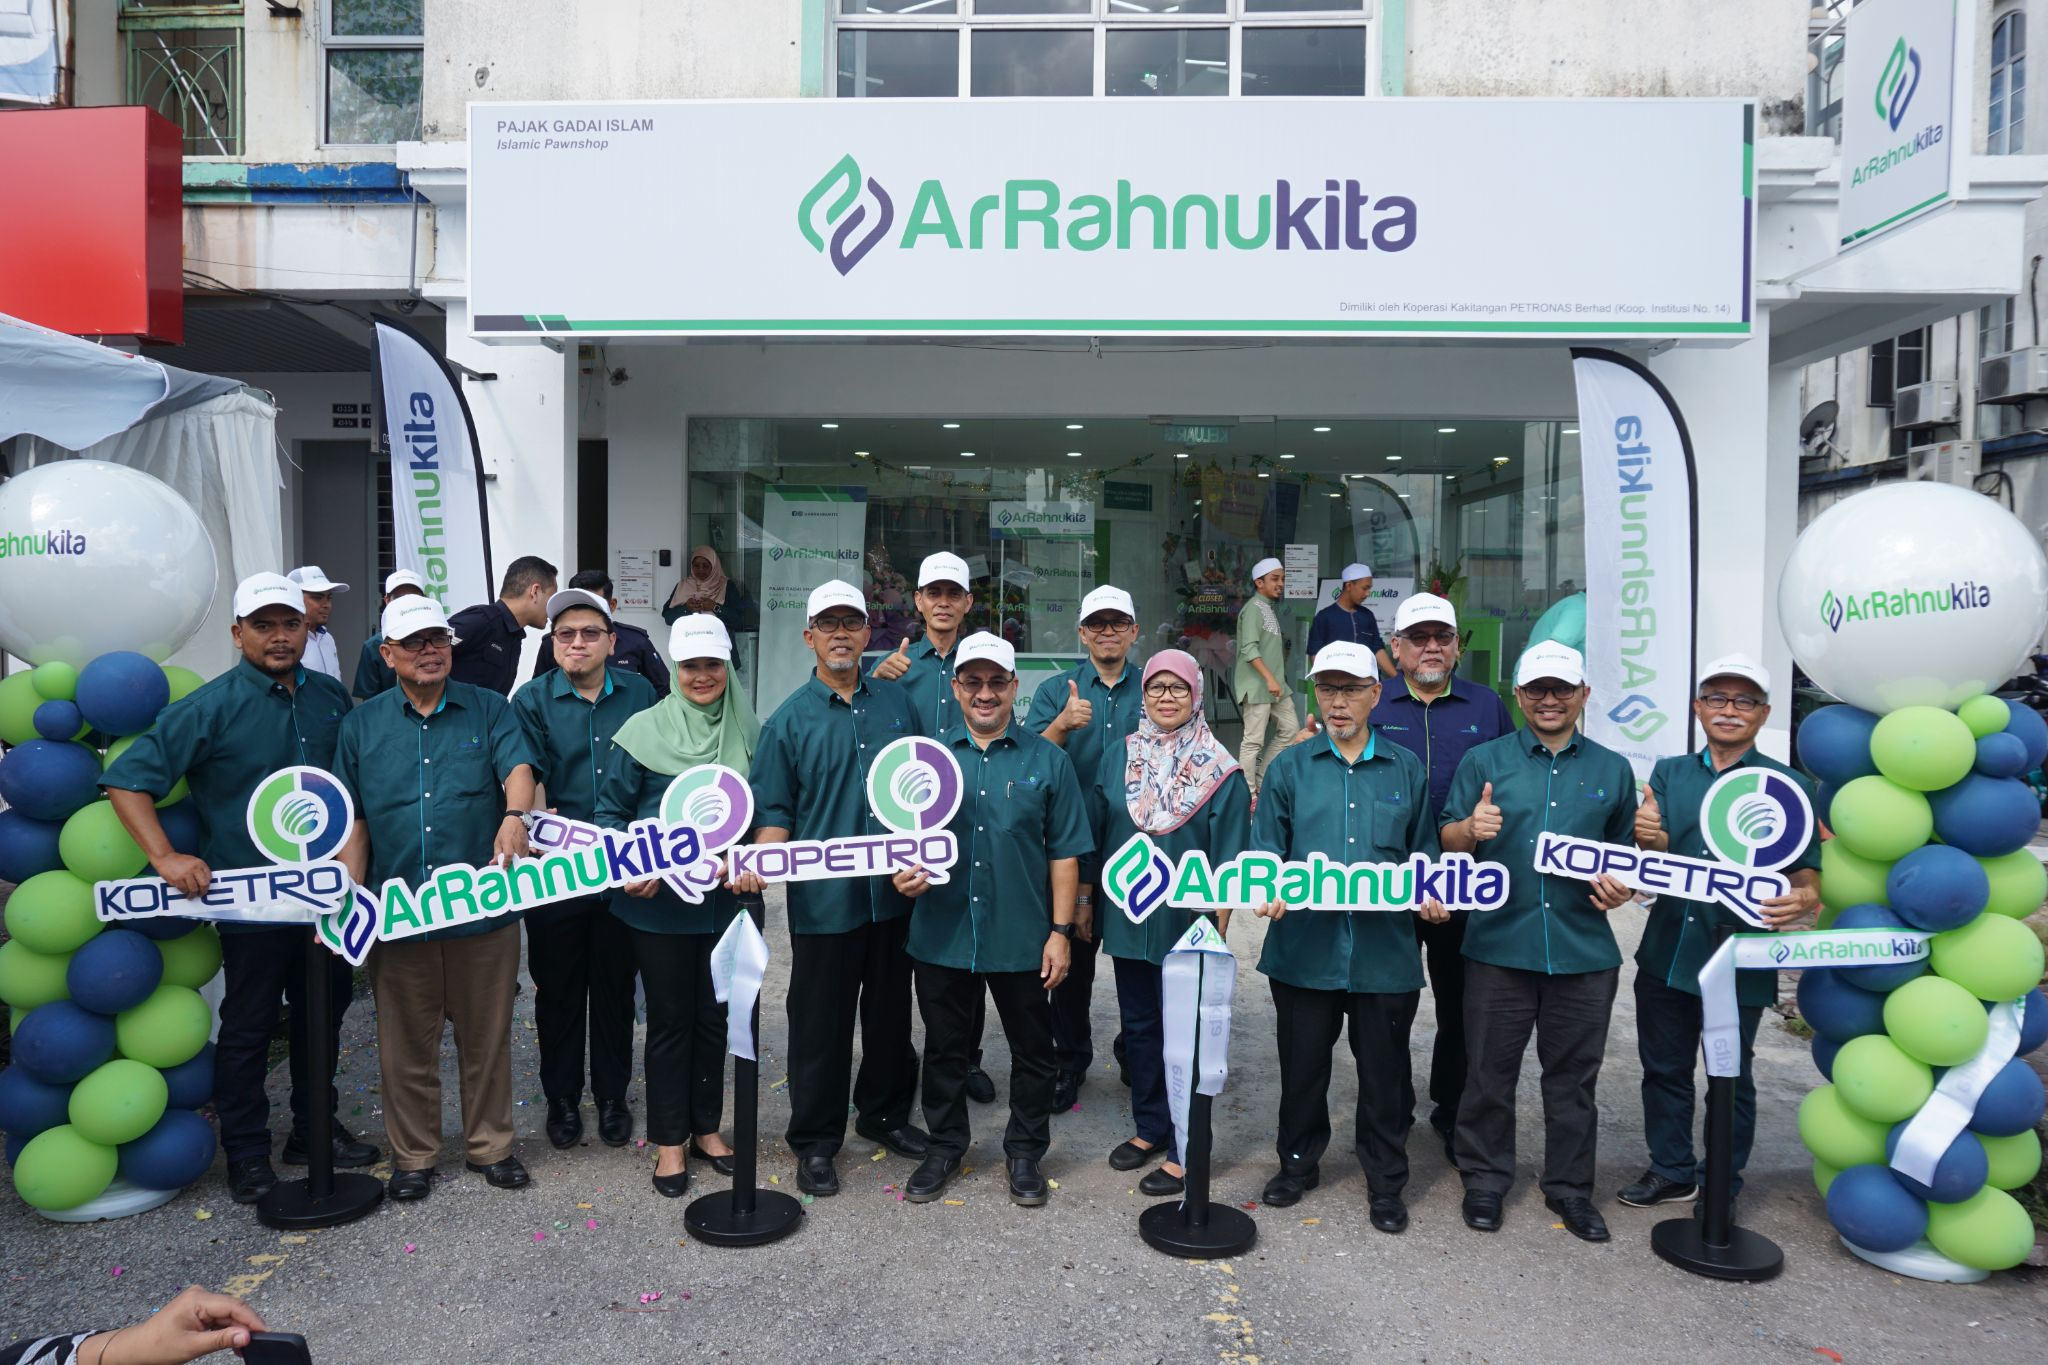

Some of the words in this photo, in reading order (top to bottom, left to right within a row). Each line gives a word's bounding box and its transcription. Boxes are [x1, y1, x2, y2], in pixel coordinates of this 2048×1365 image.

[496, 120, 549, 133] PAJAK
[553, 120, 602, 133] GADAI
[606, 119, 654, 132] ISLAM
[497, 138, 541, 150] Islamic
[544, 138, 609, 151] Pawnshop
[1851, 123, 1944, 189] ArRahnukita
[899, 179, 1418, 253] ArRahnukita
[1339, 302, 1376, 312] Dimiliki
[1378, 302, 1400, 312] oleh
[1403, 302, 1448, 314] Koperasi
[1451, 302, 1507, 315] Kakitangan
[1510, 303, 1572, 313] PETRONAS
[1575, 303, 1612, 313] Berhad
[1615, 303, 1648, 315] (Koop.
[1651, 303, 1691, 313] Institusi
[1693, 304, 1712, 314] No.
[1714, 303, 1732, 315] 14)
[404, 391, 452, 614] Rahnukita
[1013, 512, 1087, 523] ArRahnukita
[0, 530, 87, 558] ahnukita
[784, 547, 860, 560] ArRahnukita
[1846, 581, 1991, 622] ArRahnukita
[383, 824, 701, 935] ArRahnukita
[733, 835, 953, 884] KOPETRO
[1541, 838, 1784, 921] KOPETRO
[1173, 858, 1502, 906] ArRahnukita
